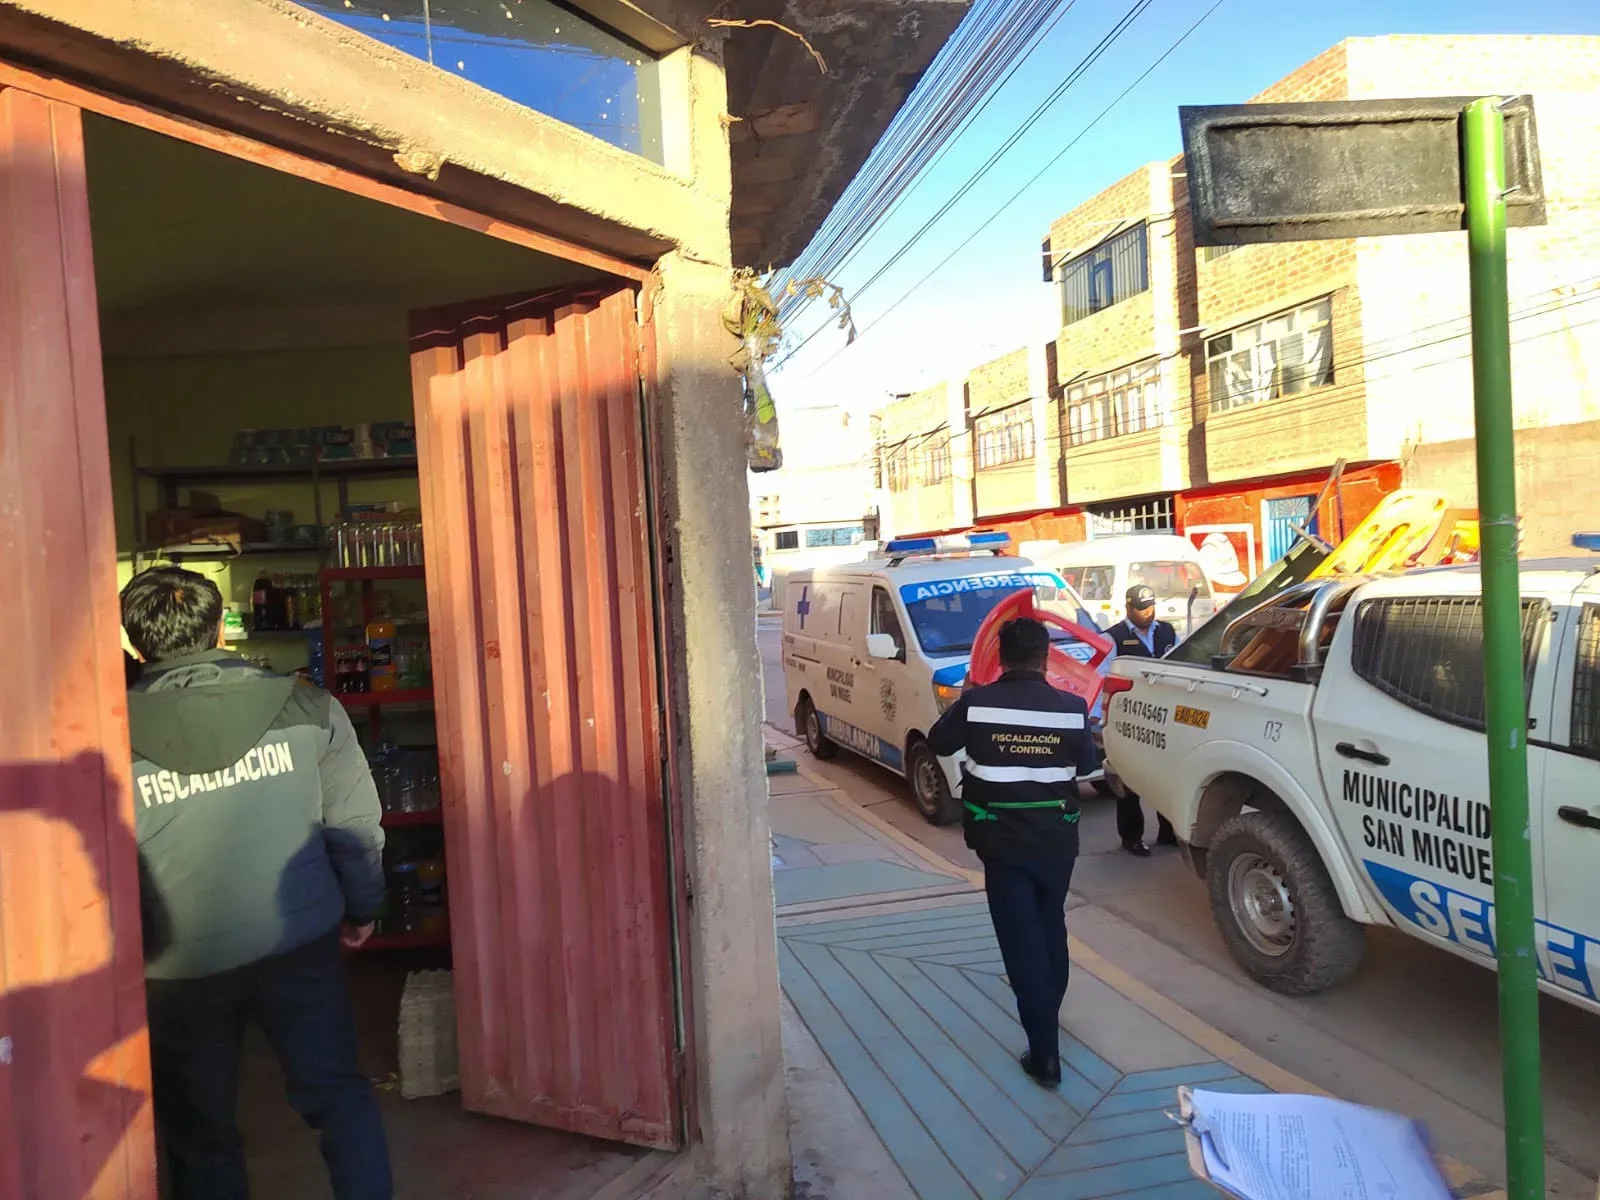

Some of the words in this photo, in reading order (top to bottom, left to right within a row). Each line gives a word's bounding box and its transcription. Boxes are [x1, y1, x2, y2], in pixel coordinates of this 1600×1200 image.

[1122, 697, 1168, 725] 914745467
[991, 733, 1061, 745] FISCALIZACIÓN
[1264, 720, 1283, 743] 03
[998, 745, 1006, 753] Y
[1009, 745, 1054, 755] CONTROL
[1363, 814, 1405, 857] SAN
[1411, 828, 1493, 886] MIGUE
